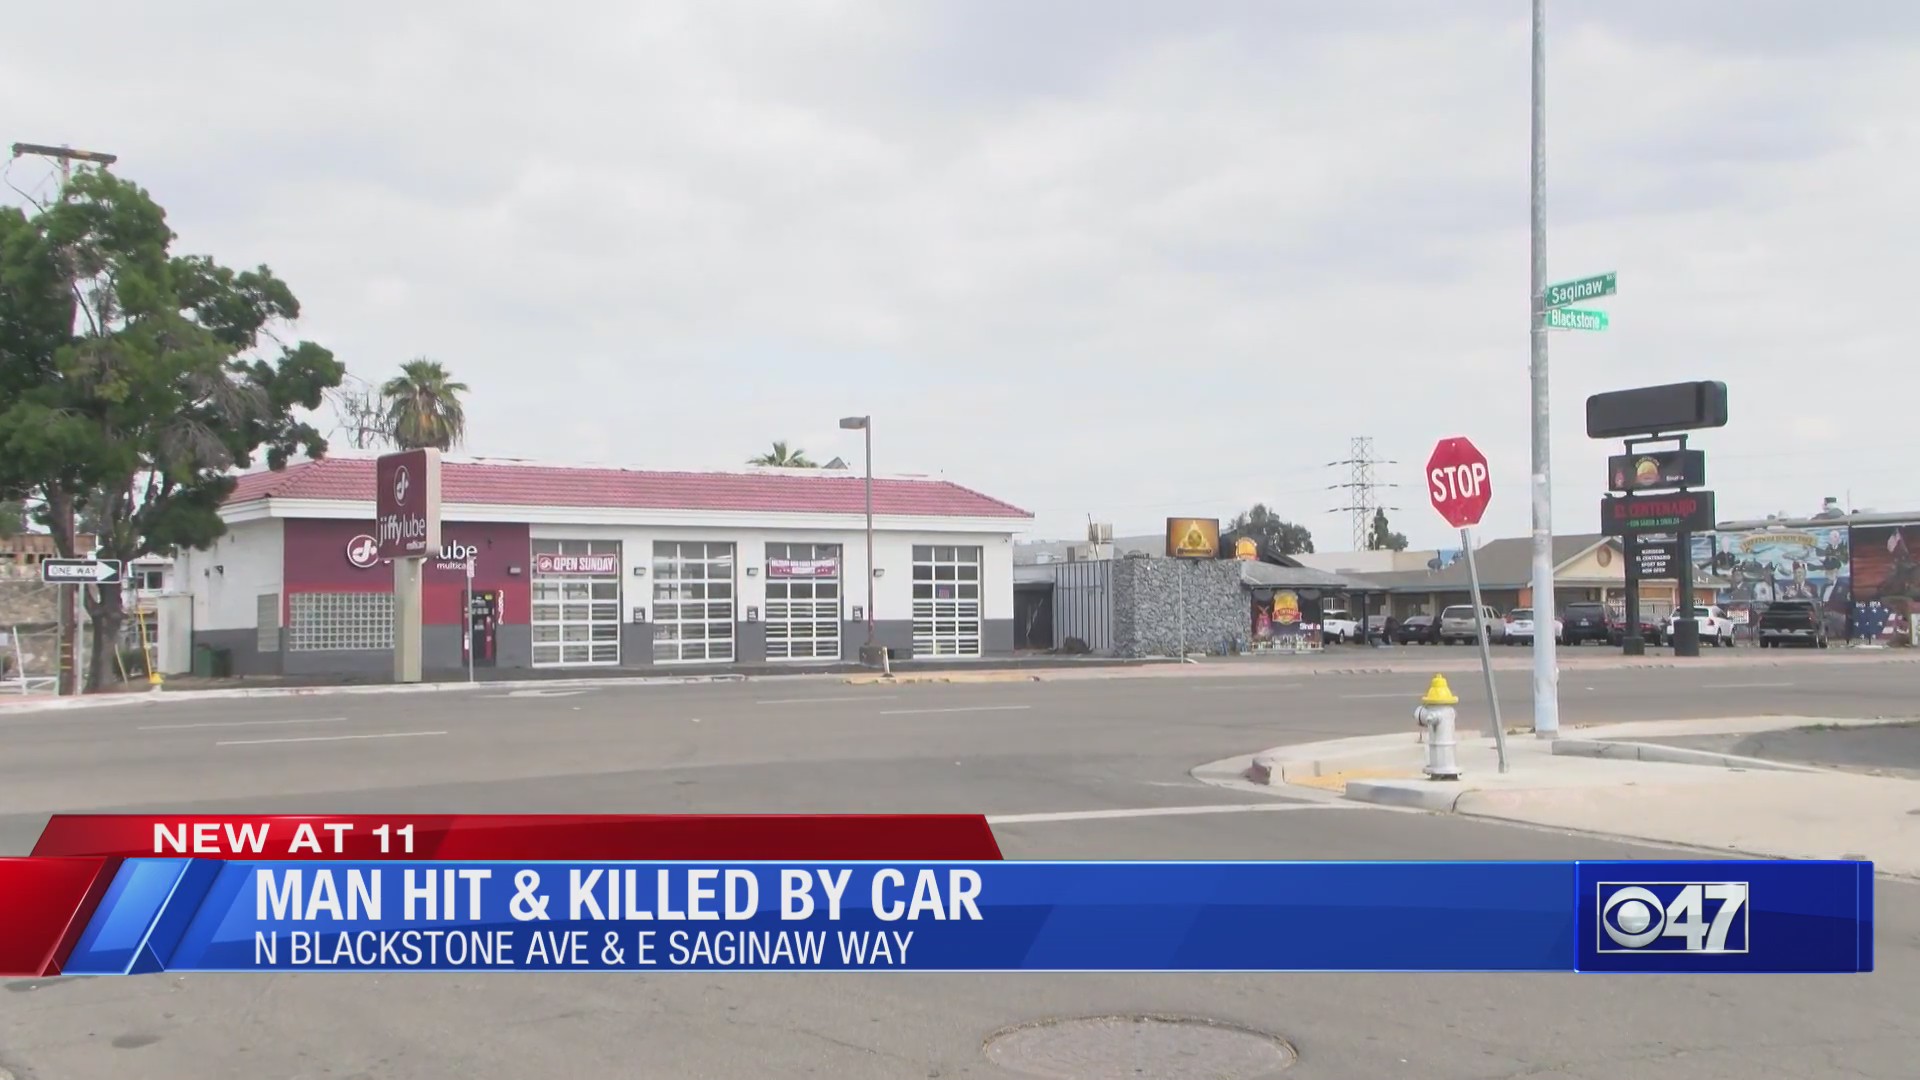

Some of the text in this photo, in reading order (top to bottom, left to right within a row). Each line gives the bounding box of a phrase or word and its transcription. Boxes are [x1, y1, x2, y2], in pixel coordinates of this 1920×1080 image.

[1551, 280, 1602, 304] Saginaw
[1551, 309, 1601, 329] Blackstone
[1431, 462, 1487, 502] STOP
[51, 567, 96, 576] ONE WAY
[554, 557, 614, 571] OPEN SUNDAY
